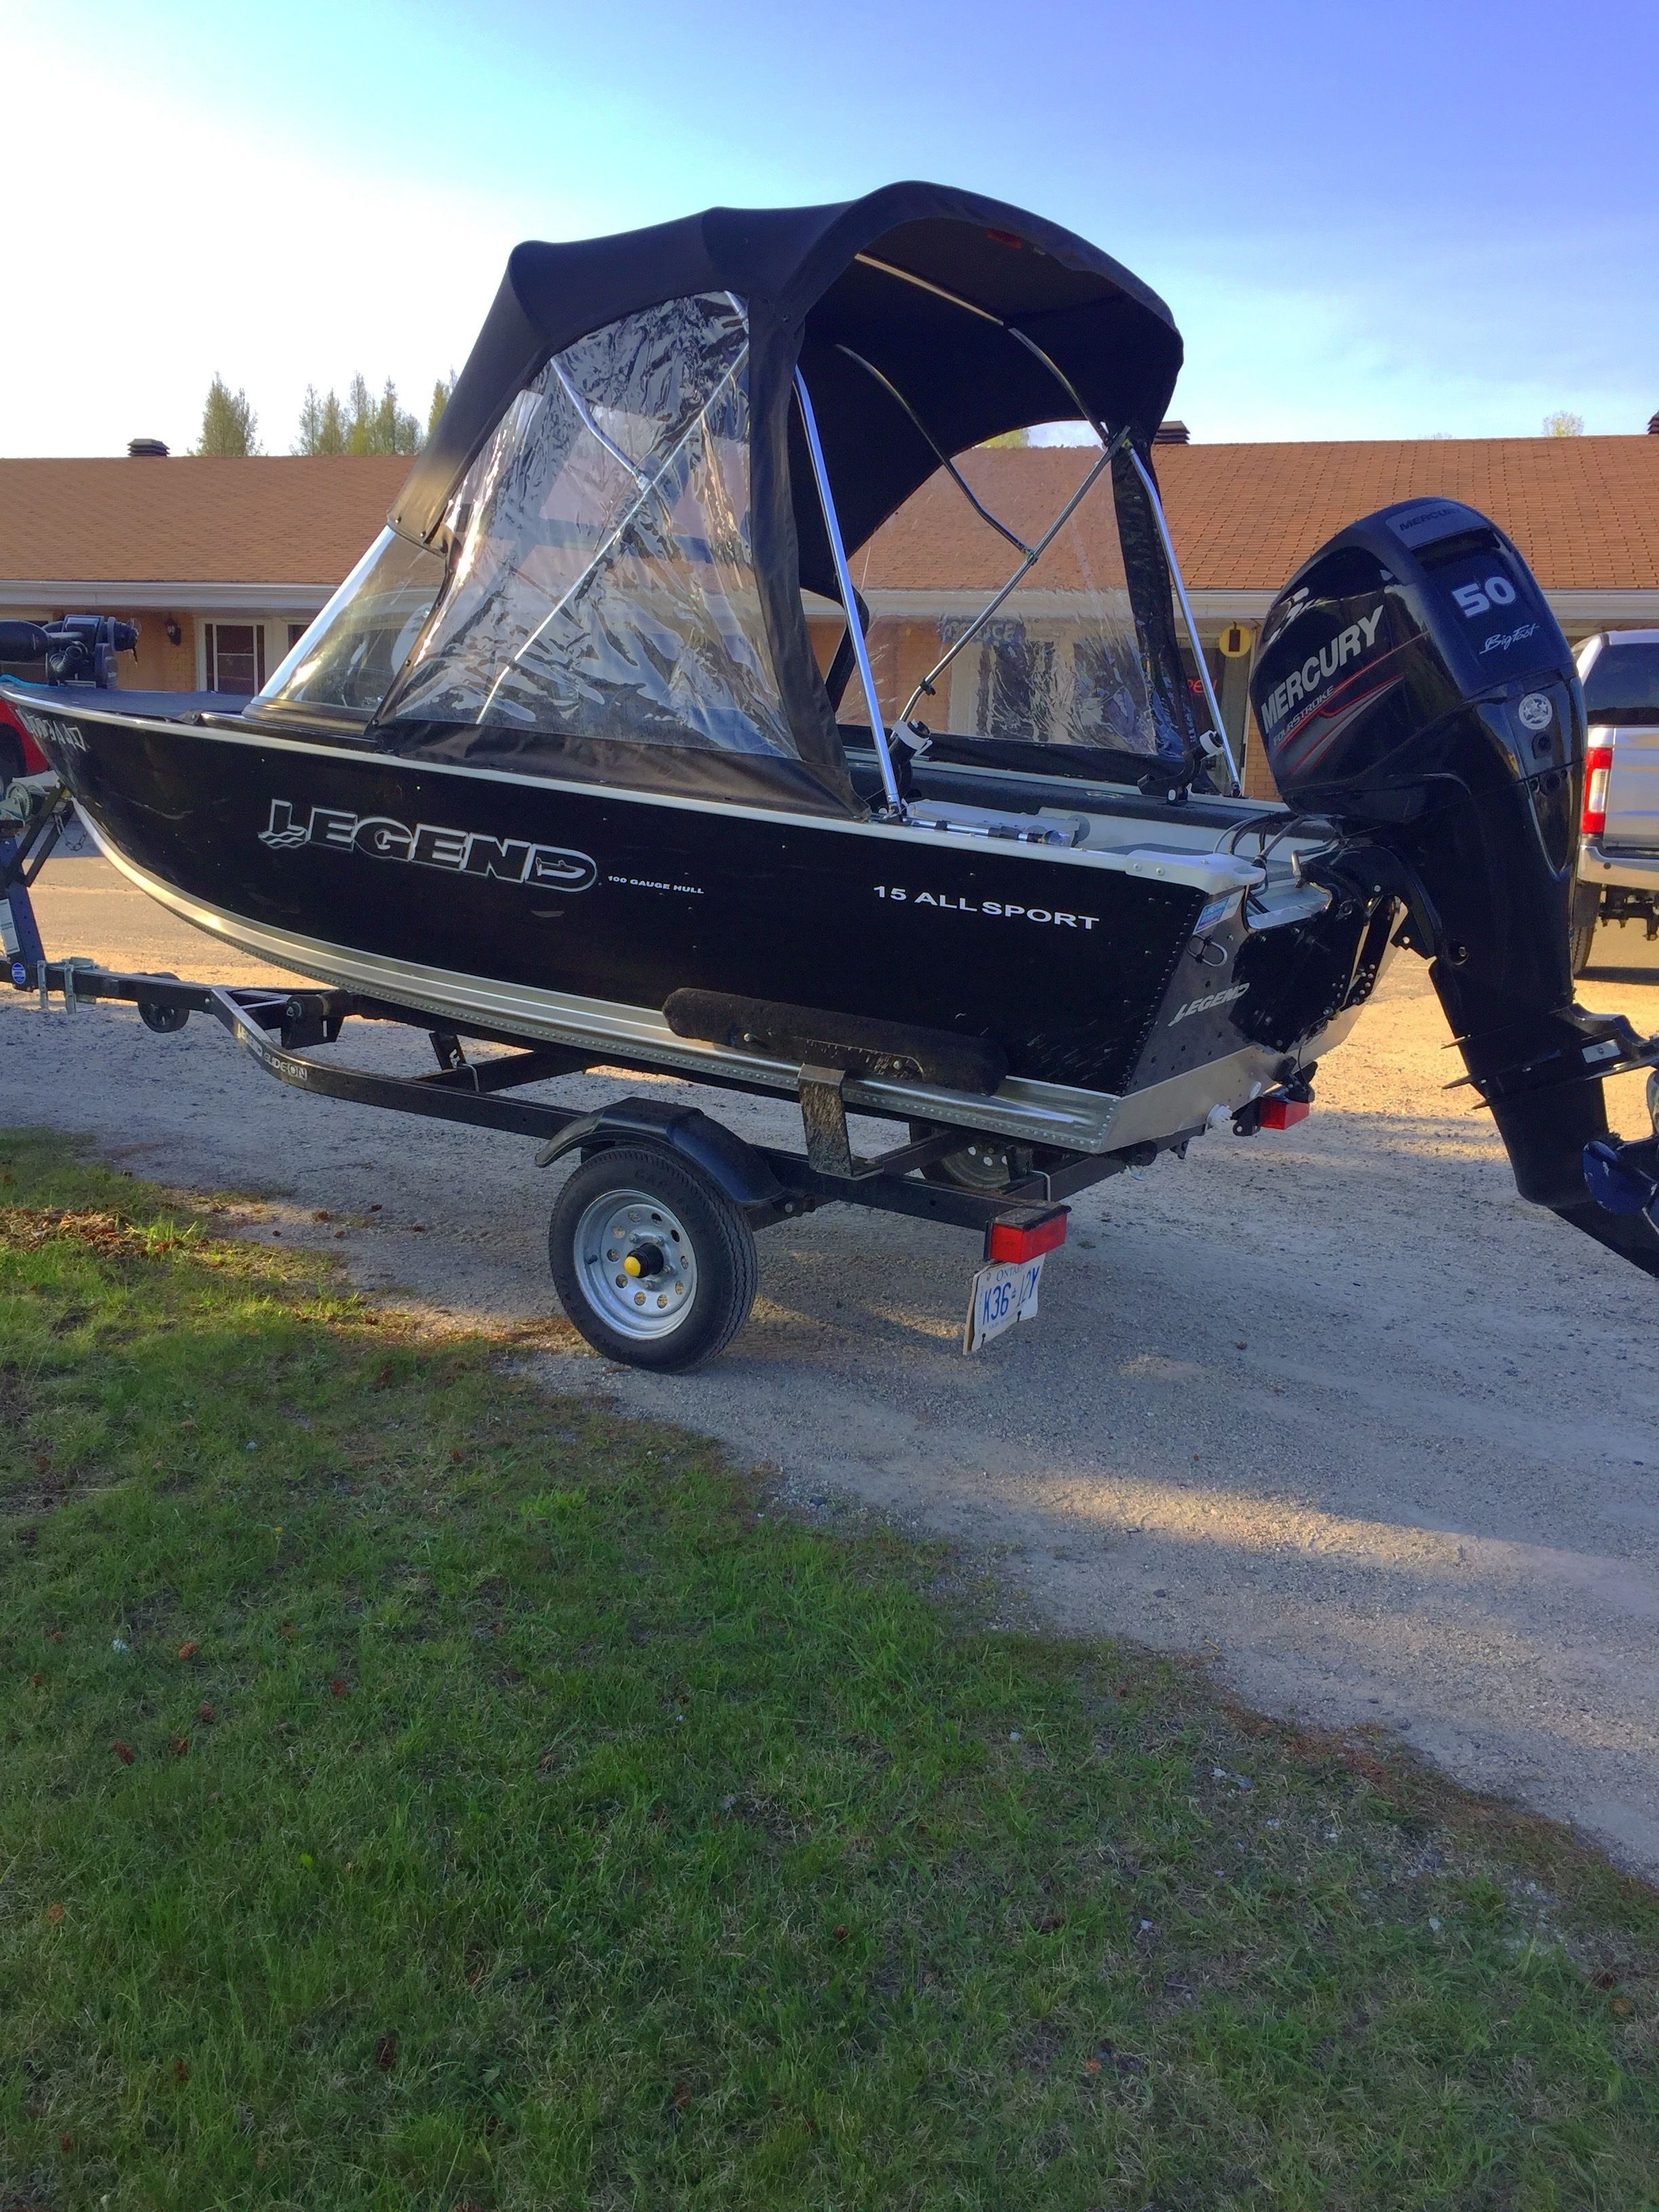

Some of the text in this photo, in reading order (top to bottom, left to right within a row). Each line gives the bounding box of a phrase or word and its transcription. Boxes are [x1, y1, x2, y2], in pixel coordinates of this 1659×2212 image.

[1452, 576, 1516, 618] 50
[1261, 605, 1384, 735] MERCURY
[1273, 685, 1334, 745] FOURSTROKE
[258, 798, 598, 893] LEGEND
[630, 879, 671, 890] GAUGE
[673, 885, 704, 894] HULL
[874, 886, 1099, 929] 15 ALL SPORT
[1168, 982, 1250, 1027] LEGEND
